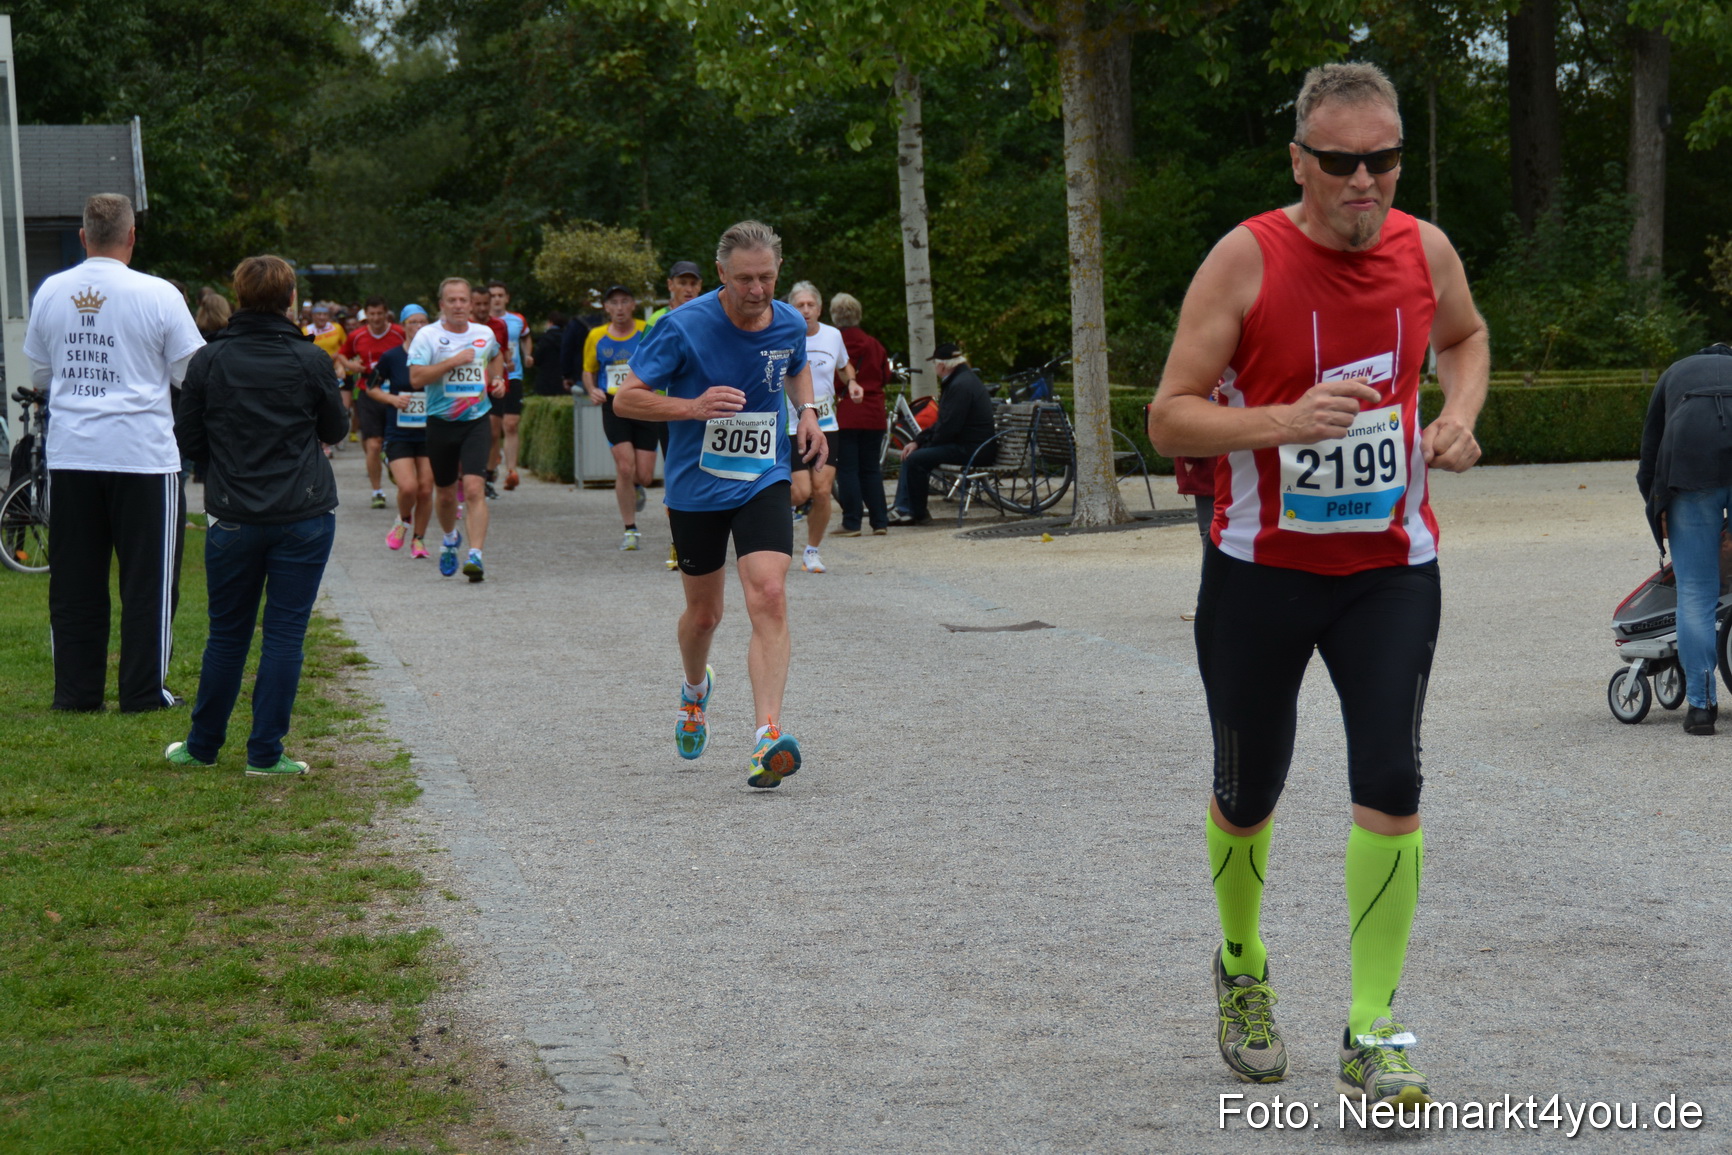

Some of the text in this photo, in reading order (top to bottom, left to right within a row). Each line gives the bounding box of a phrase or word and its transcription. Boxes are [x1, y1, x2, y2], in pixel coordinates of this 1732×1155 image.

[81, 315, 95, 327] IM
[67, 350, 109, 364] SEINER
[448, 367, 482, 382] 2629
[1342, 365, 1374, 381] DEHN
[72, 384, 107, 398] JESUS
[735, 419, 768, 427] Neumarkt
[1347, 422, 1387, 438] umarkt
[711, 428, 772, 455] 3059
[1296, 438, 1397, 490] 2199
[1326, 500, 1372, 518] Peter
